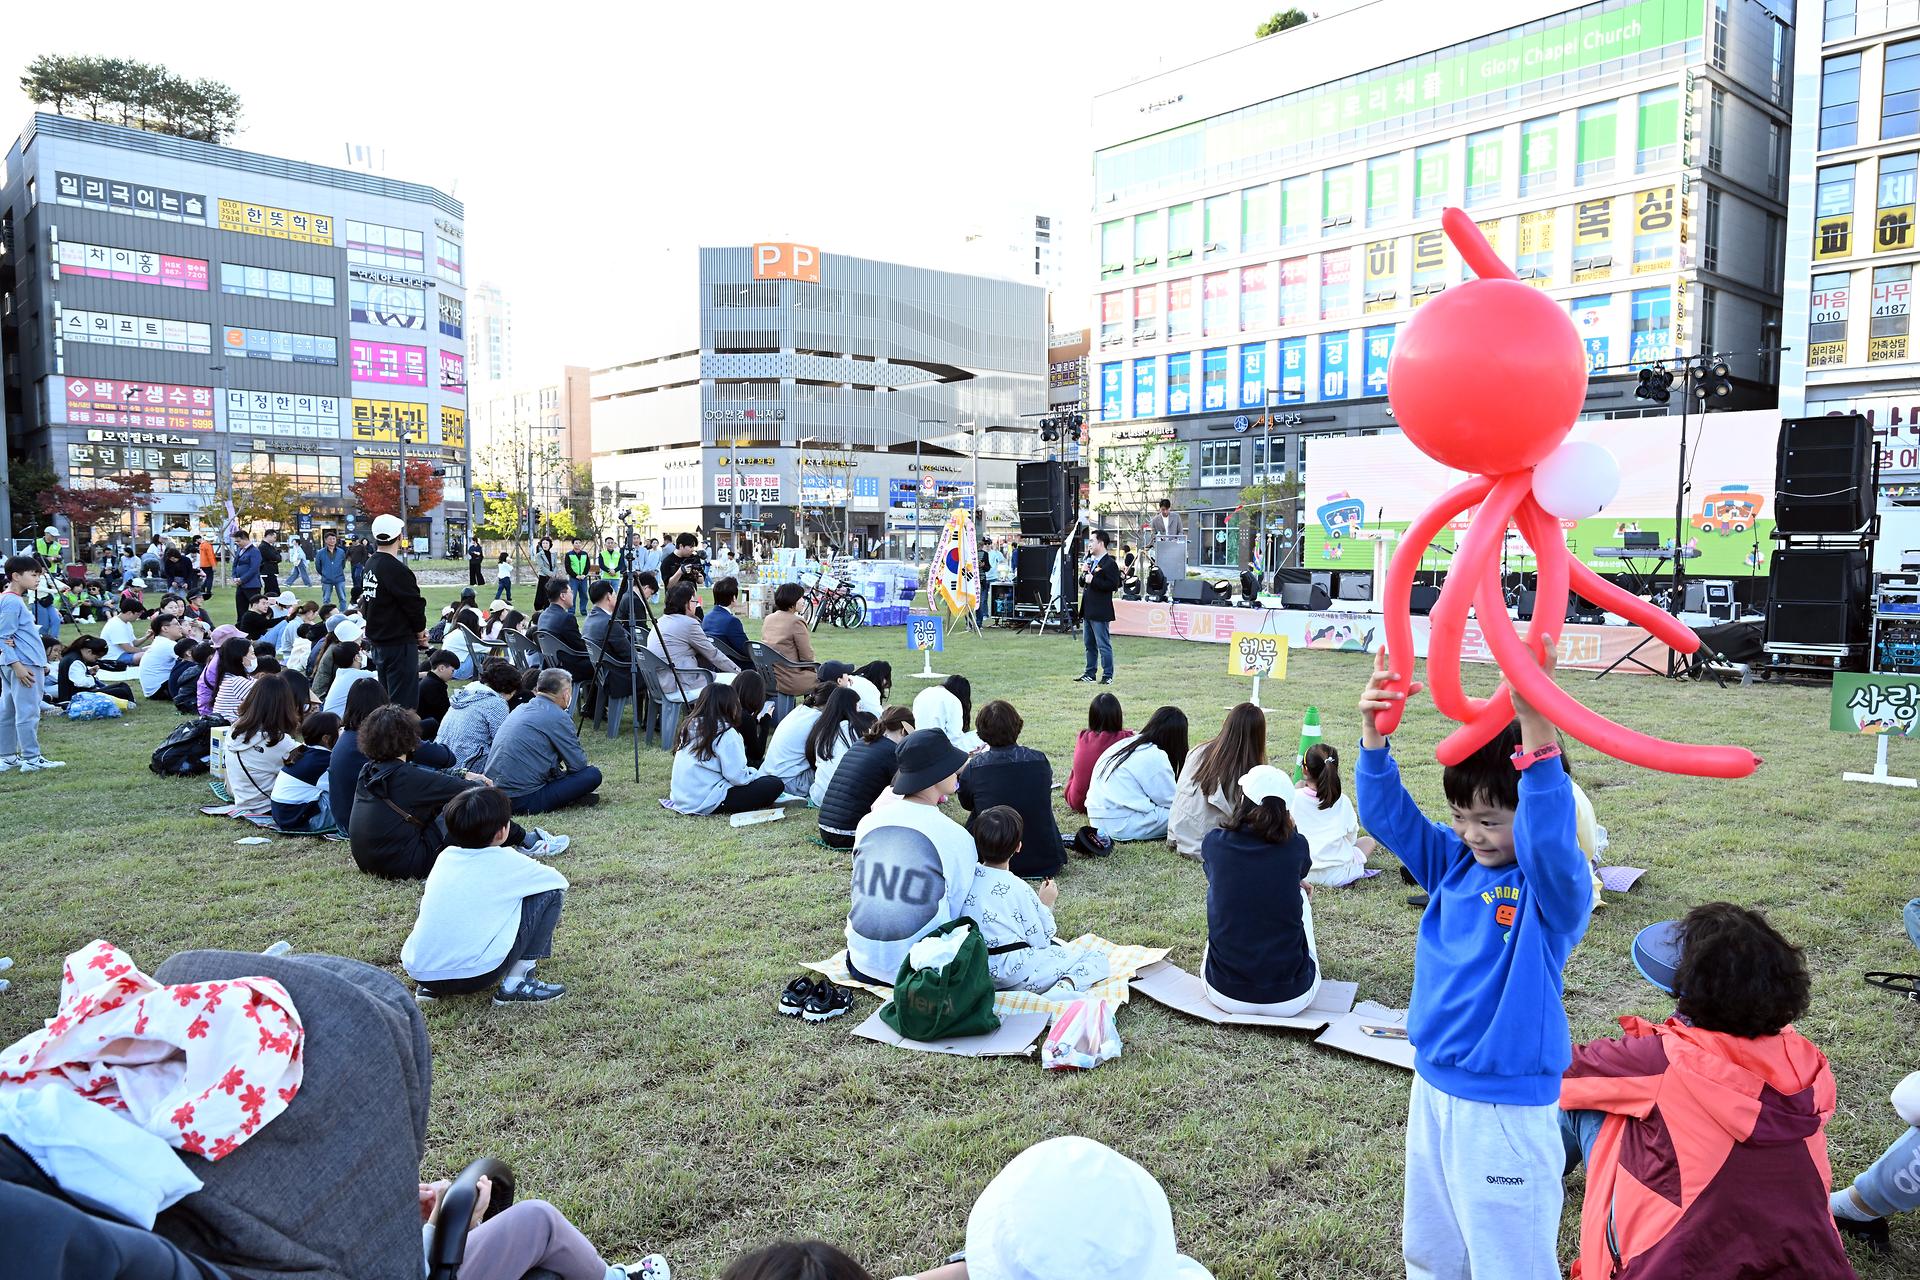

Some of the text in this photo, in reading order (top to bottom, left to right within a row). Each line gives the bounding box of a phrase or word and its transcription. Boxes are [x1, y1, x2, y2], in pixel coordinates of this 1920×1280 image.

[1481, 19, 1641, 78] Glory Chapel Church
[247, 208, 328, 234] 한뜻학원
[90, 247, 153, 274] 차이홍
[758, 245, 781, 275] P
[793, 246, 814, 276] P
[1813, 284, 1910, 309] 마음 나무
[1817, 304, 1907, 321] 010 4187
[1811, 338, 1906, 354] 심리검사 가족상담
[1811, 349, 1905, 364] 미술치료 언어치료
[353, 345, 424, 382] 귀코목
[94, 382, 210, 407] 박선생수학
[230, 393, 333, 413] 다정한의원
[192, 419, 213, 430] 5998
[103, 431, 181, 444] 모던필라테스
[72, 448, 213, 467] 모던필라테스
[1878, 448, 1918, 469] 영어
[764, 477, 779, 487] 진료
[739, 488, 758, 503] 야간
[761, 488, 780, 503] 진료
[913, 619, 936, 641] 정음
[1239, 637, 1277, 665] 행복
[1846, 683, 1920, 720] 사랑
